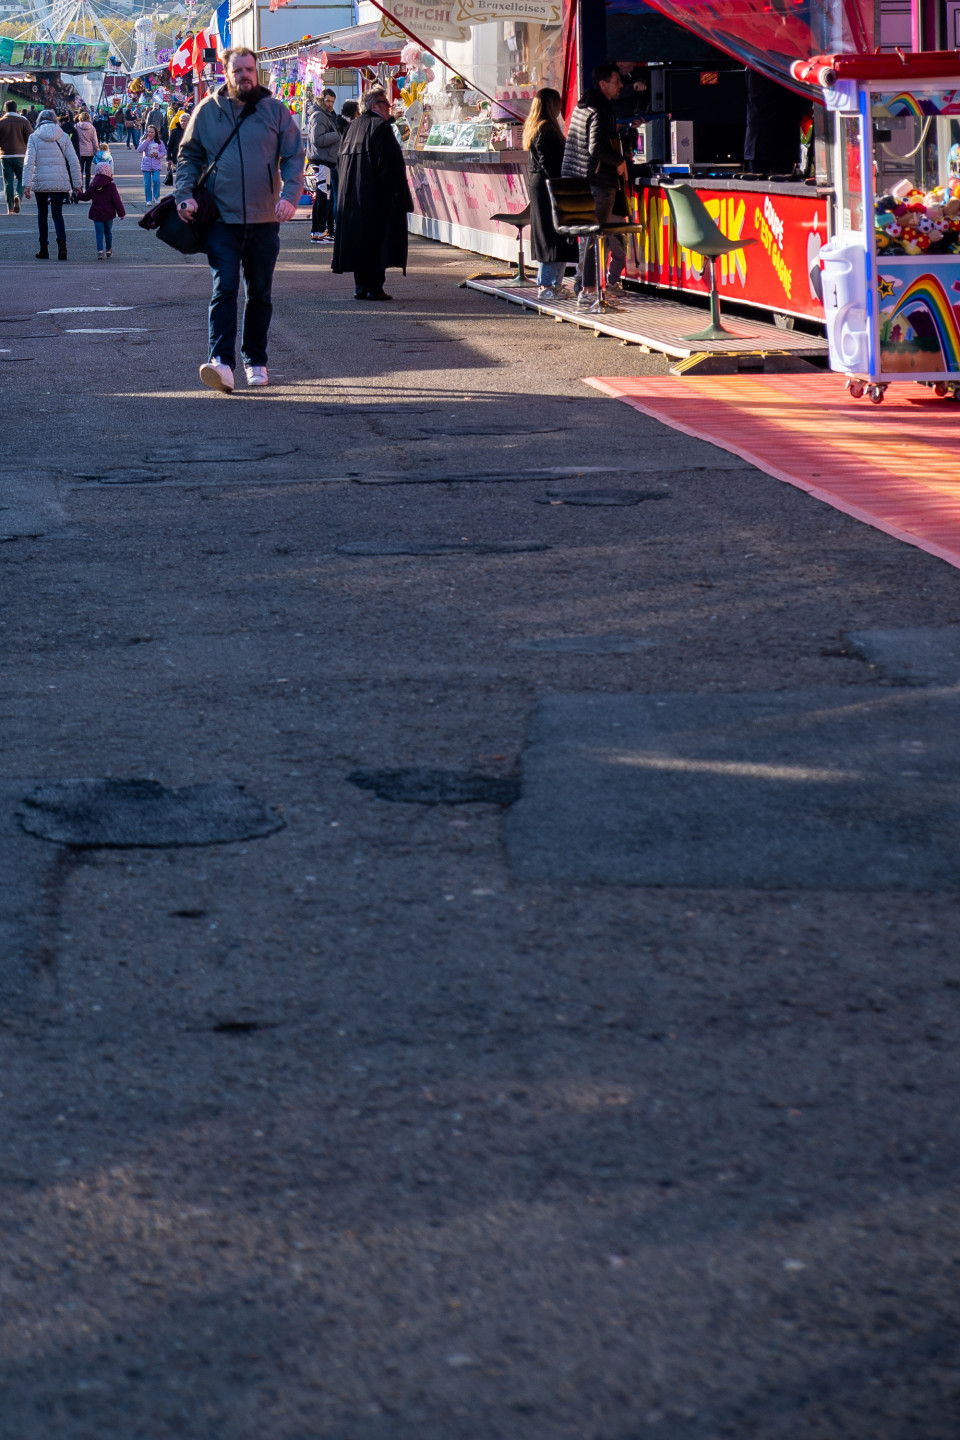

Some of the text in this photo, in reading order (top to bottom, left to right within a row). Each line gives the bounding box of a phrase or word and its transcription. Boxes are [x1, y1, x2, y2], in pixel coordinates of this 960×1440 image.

[393, 3, 453, 23] CHI-CHI
[478, 0, 546, 14] Bruxelloises
[409, 21, 445, 33] Maison
[764, 195, 784, 250] COUPÉ
[754, 207, 792, 300] C'EST GAGNÉ
